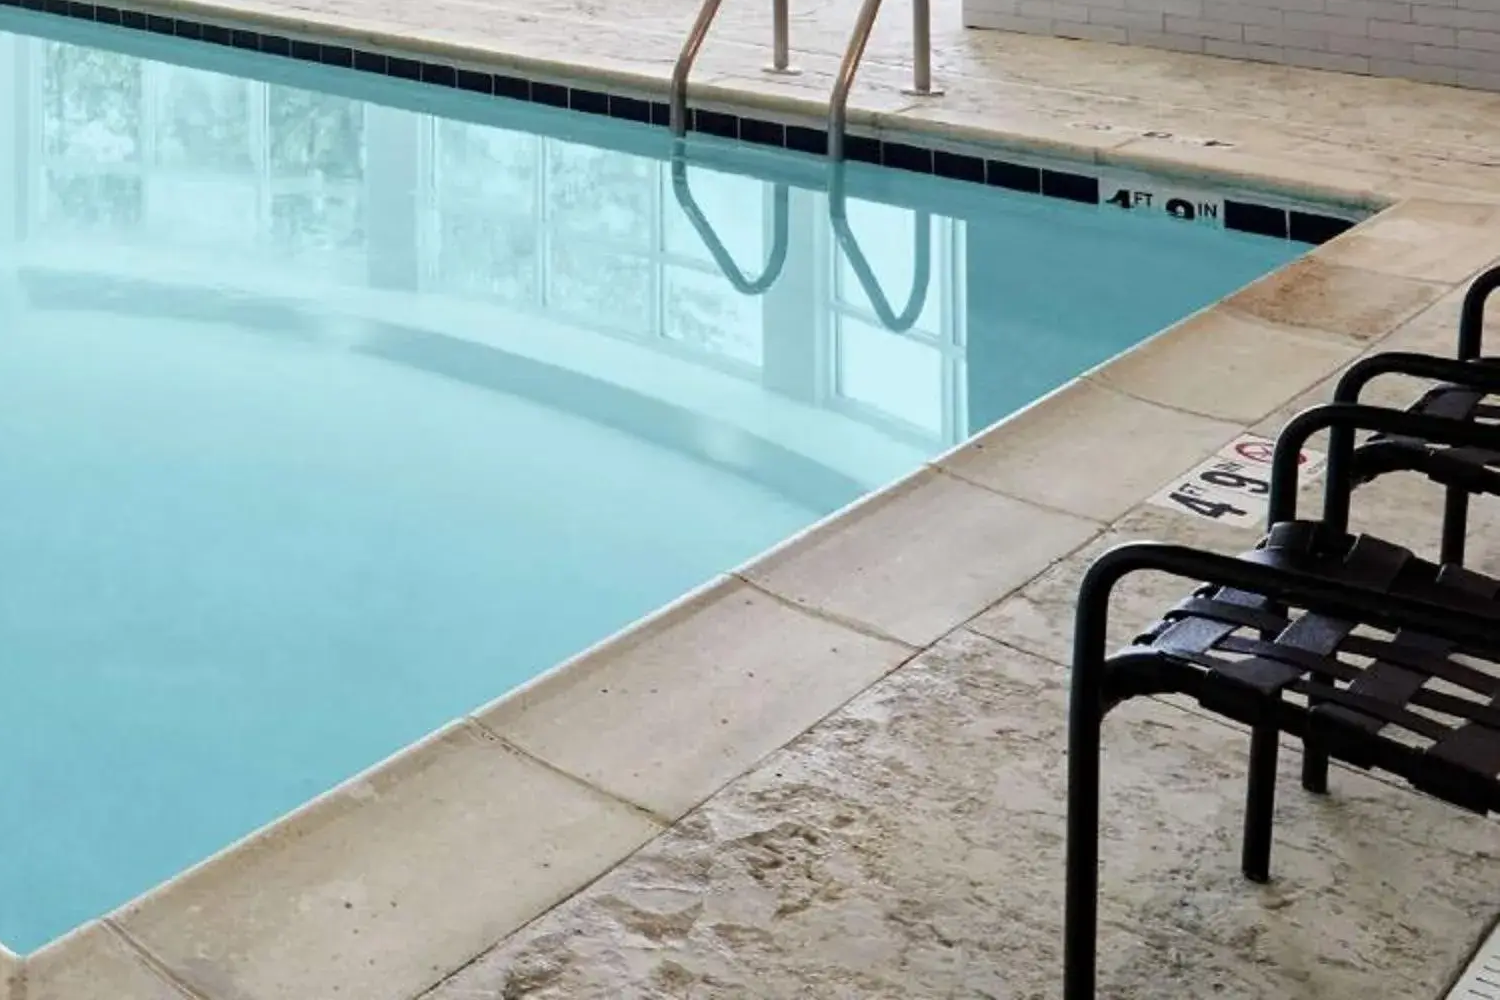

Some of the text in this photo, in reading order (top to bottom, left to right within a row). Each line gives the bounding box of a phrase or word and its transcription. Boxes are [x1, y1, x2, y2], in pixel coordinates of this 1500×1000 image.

[1133, 192, 1154, 207] FT
[1198, 203, 1218, 219] IN
[1199, 471, 1270, 494] 9
[1168, 491, 1248, 519] 4
